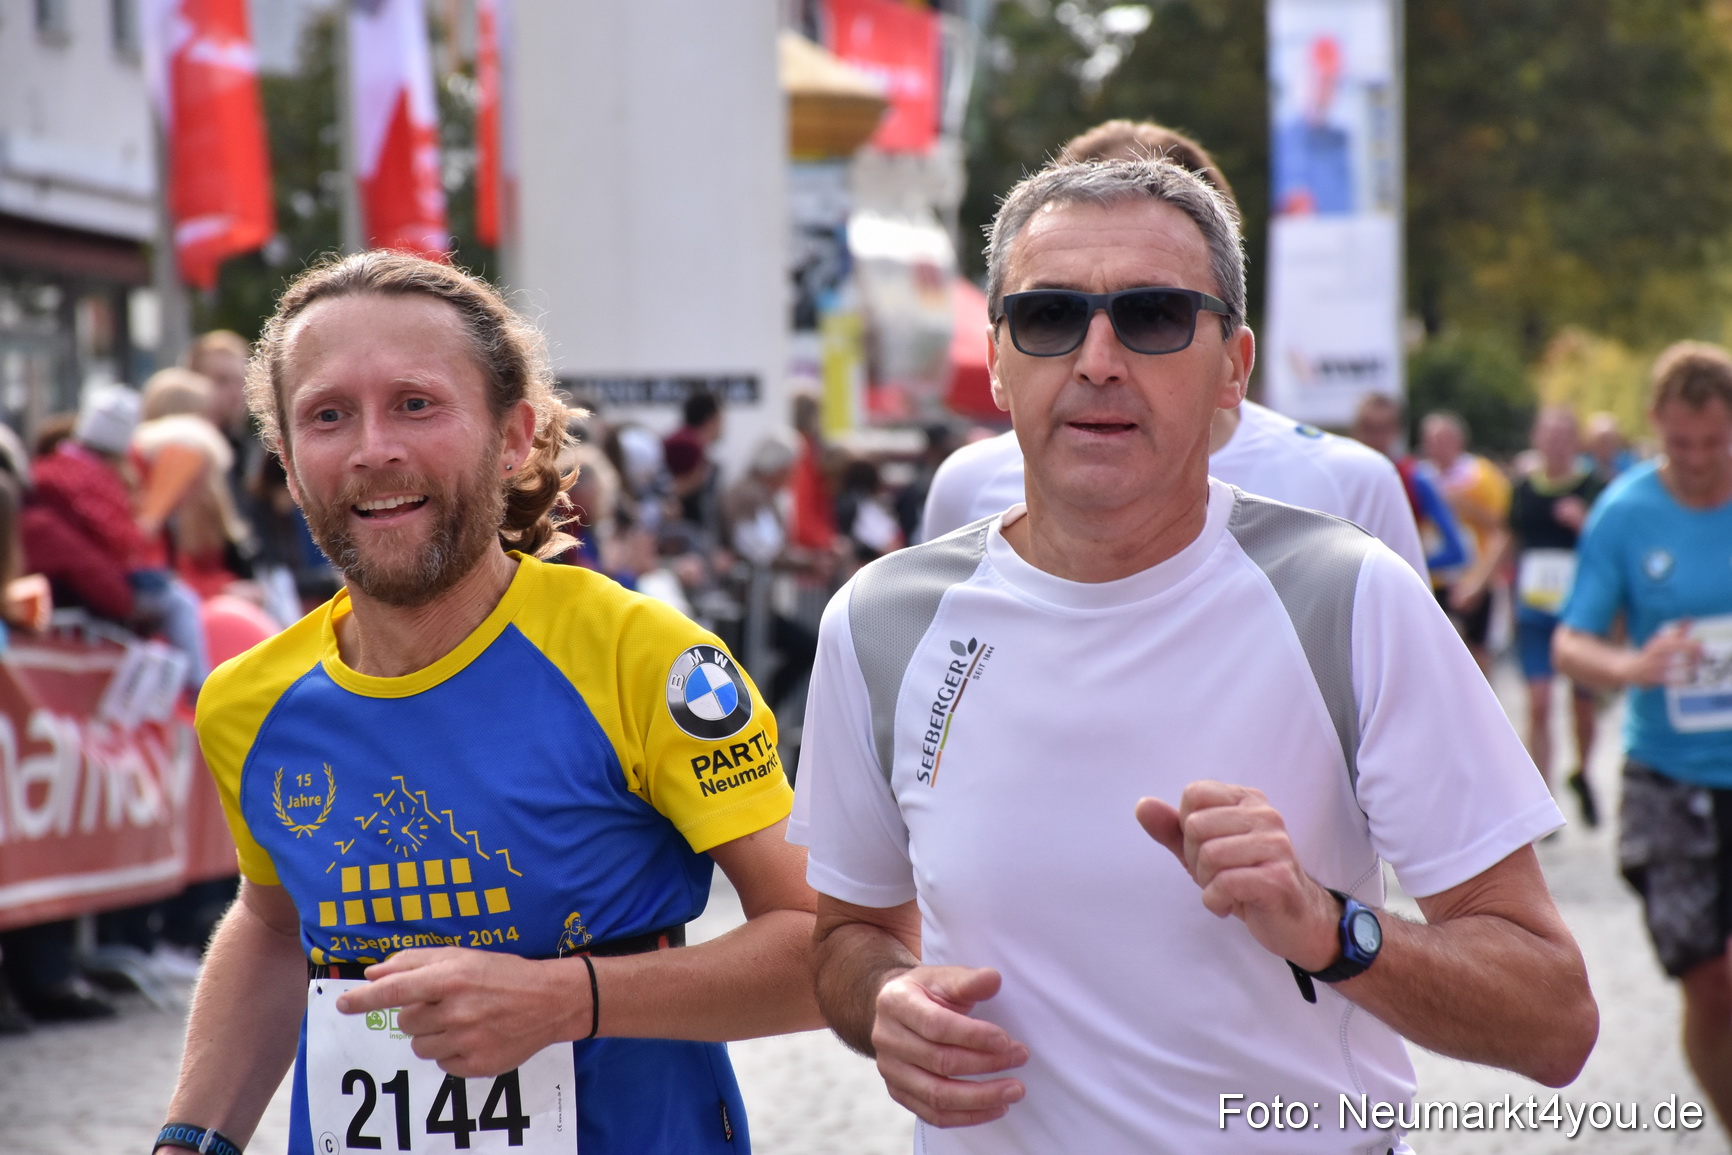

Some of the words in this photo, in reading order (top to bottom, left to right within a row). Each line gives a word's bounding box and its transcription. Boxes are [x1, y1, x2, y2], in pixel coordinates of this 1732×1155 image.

[670, 648, 729, 691] BMW
[973, 662, 986, 681] SEIT
[983, 646, 995, 662] 1844
[916, 659, 968, 785] SEEBERGER
[690, 730, 773, 779] PARTL
[699, 753, 778, 798] Neumarkt
[287, 793, 322, 809] Jahre
[295, 773, 312, 788] 15
[330, 931, 462, 953] 21.September
[468, 926, 520, 947] 2014
[341, 1068, 531, 1152] 2144
